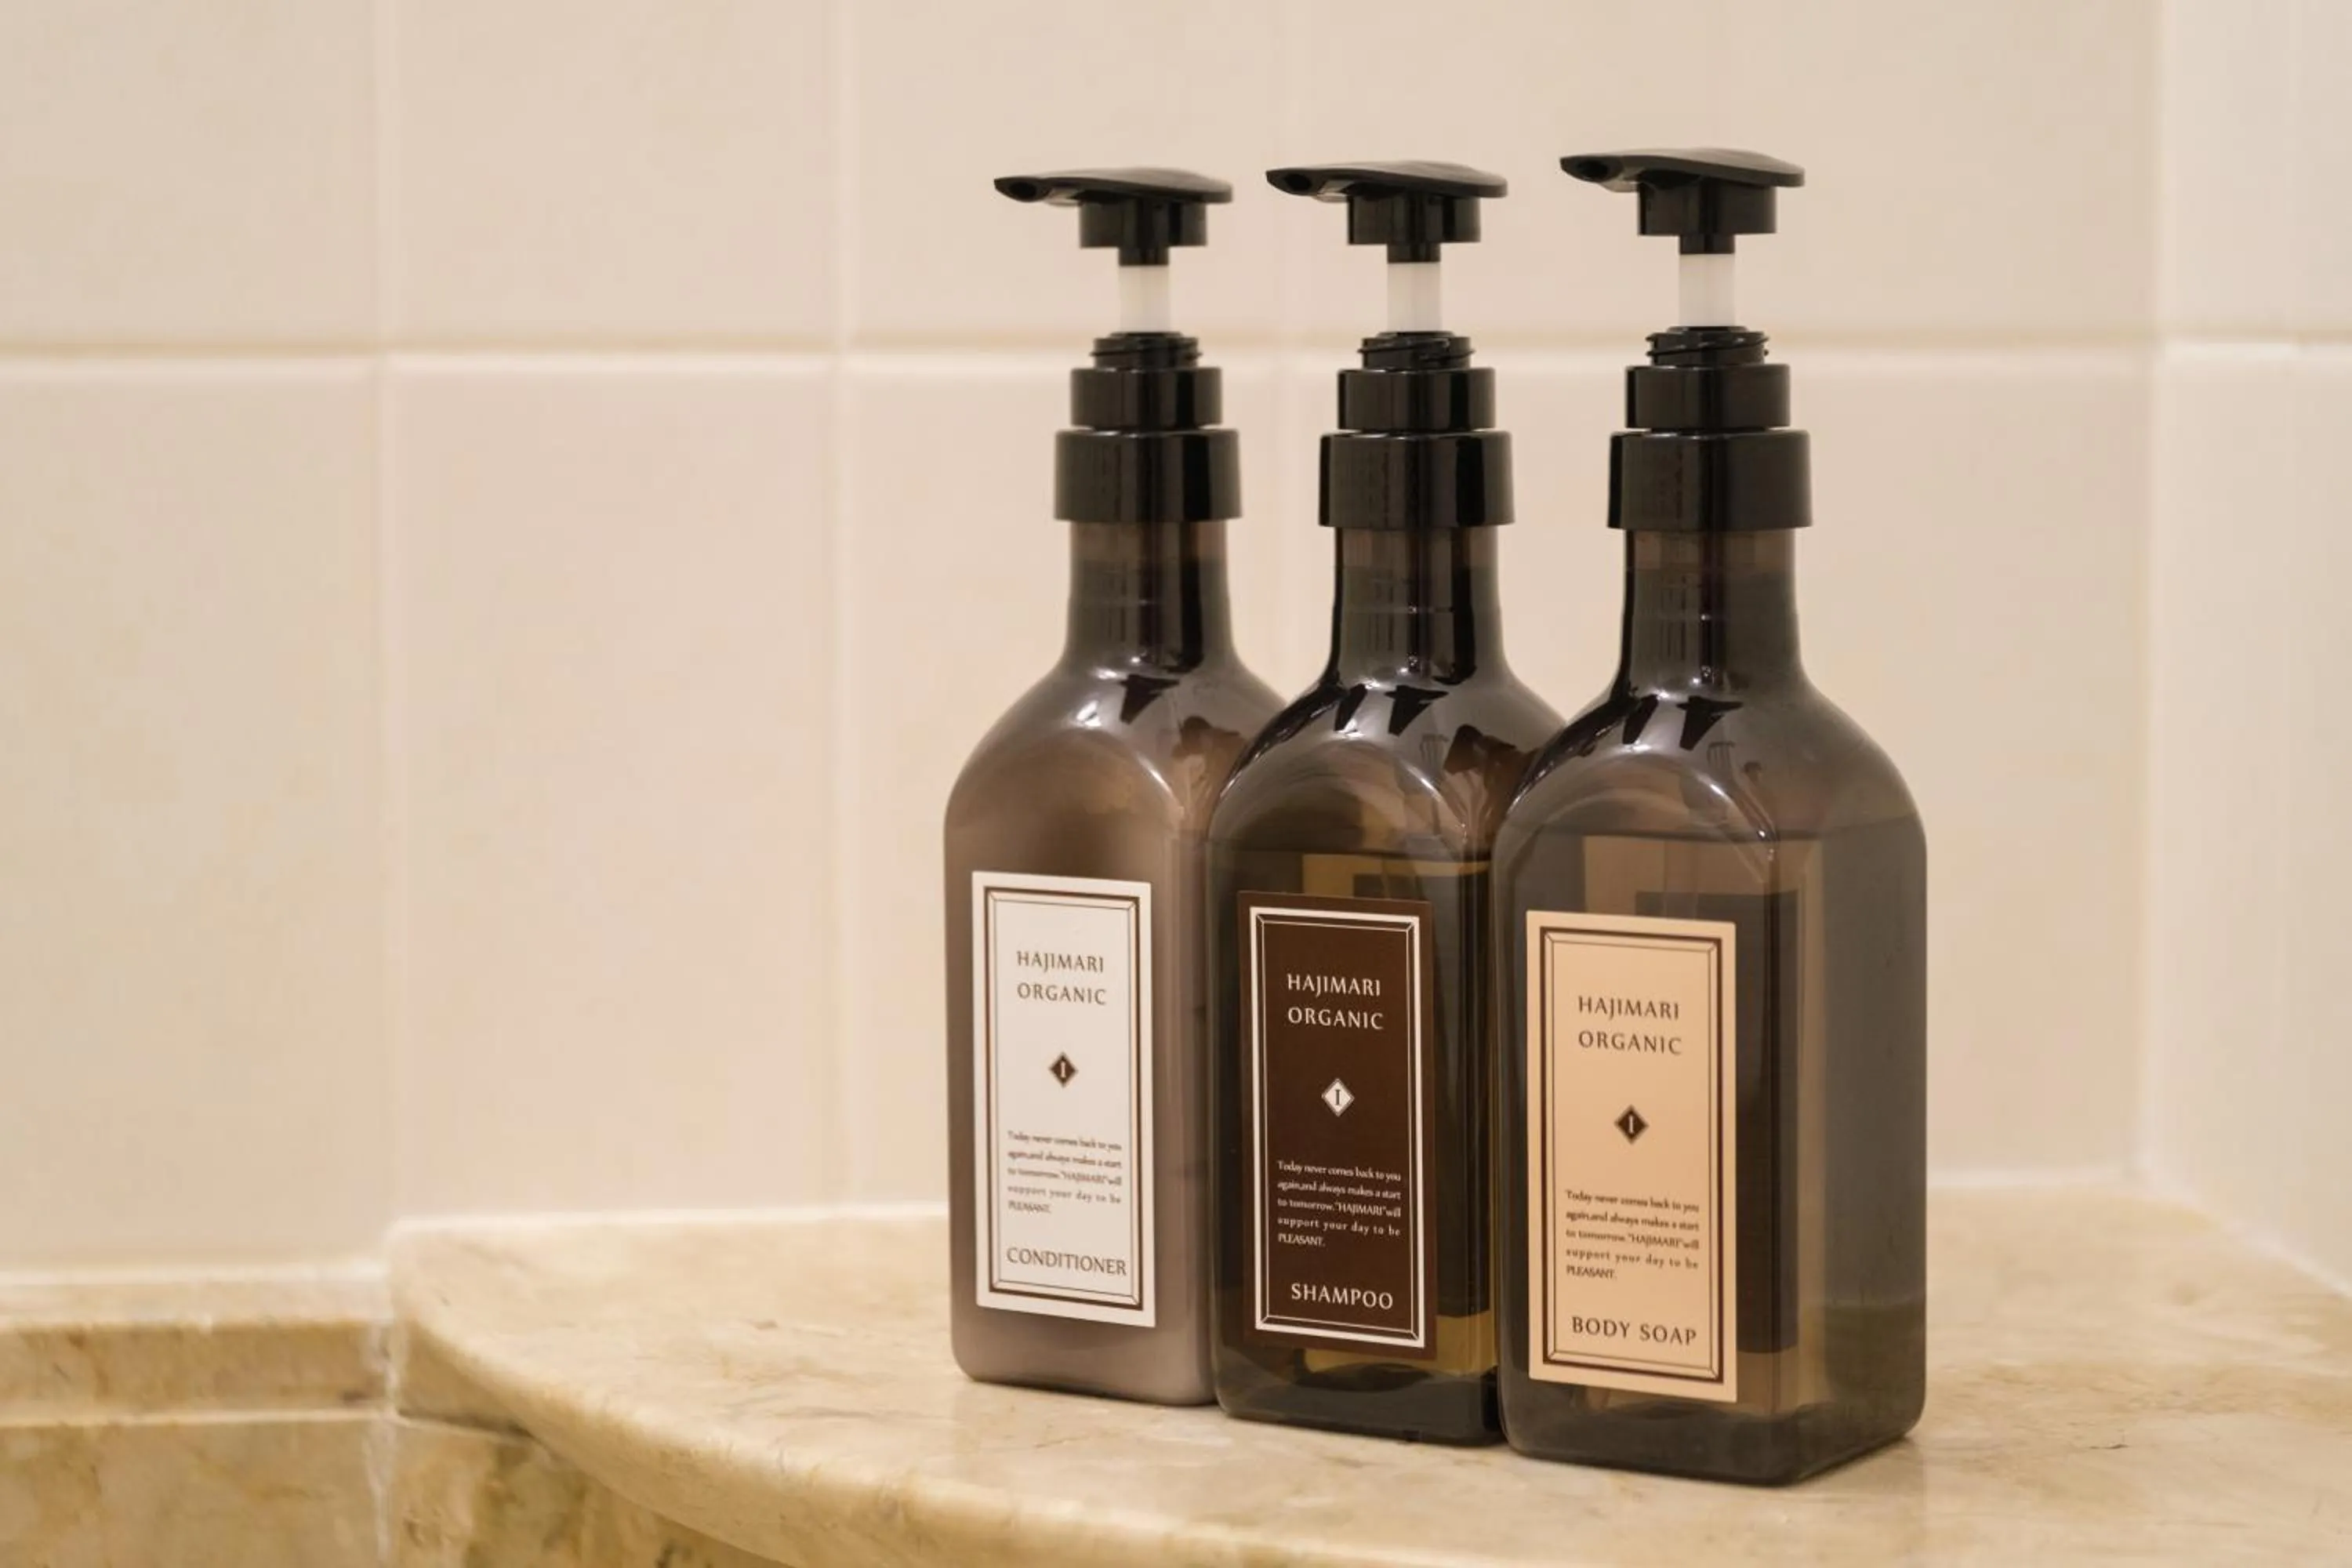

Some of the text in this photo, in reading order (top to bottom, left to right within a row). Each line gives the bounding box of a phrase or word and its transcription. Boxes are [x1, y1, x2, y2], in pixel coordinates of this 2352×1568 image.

[1017, 950, 1104, 974] HAJIMARI
[1017, 983, 1106, 1006] ORGANIC
[1287, 973, 1381, 997] HAJIMARI
[1287, 1007, 1384, 1030] ORGANIC
[1578, 996, 1679, 1020] HAJIMARI
[1578, 1031, 1682, 1055] ORGANIC
[1277, 1160, 1401, 1183] Today never comes back to you
[1277, 1198, 1287, 1207] to
[1319, 1182, 1346, 1196] always
[1348, 1185, 1374, 1196] makes
[1382, 1190, 1401, 1200] start
[1277, 1217, 1401, 1236] support your day to be
[1007, 1247, 1127, 1276] CONDITIONER
[1290, 1283, 1393, 1310] SHAMPOO
[1571, 1316, 1697, 1347] BODY SOAP
